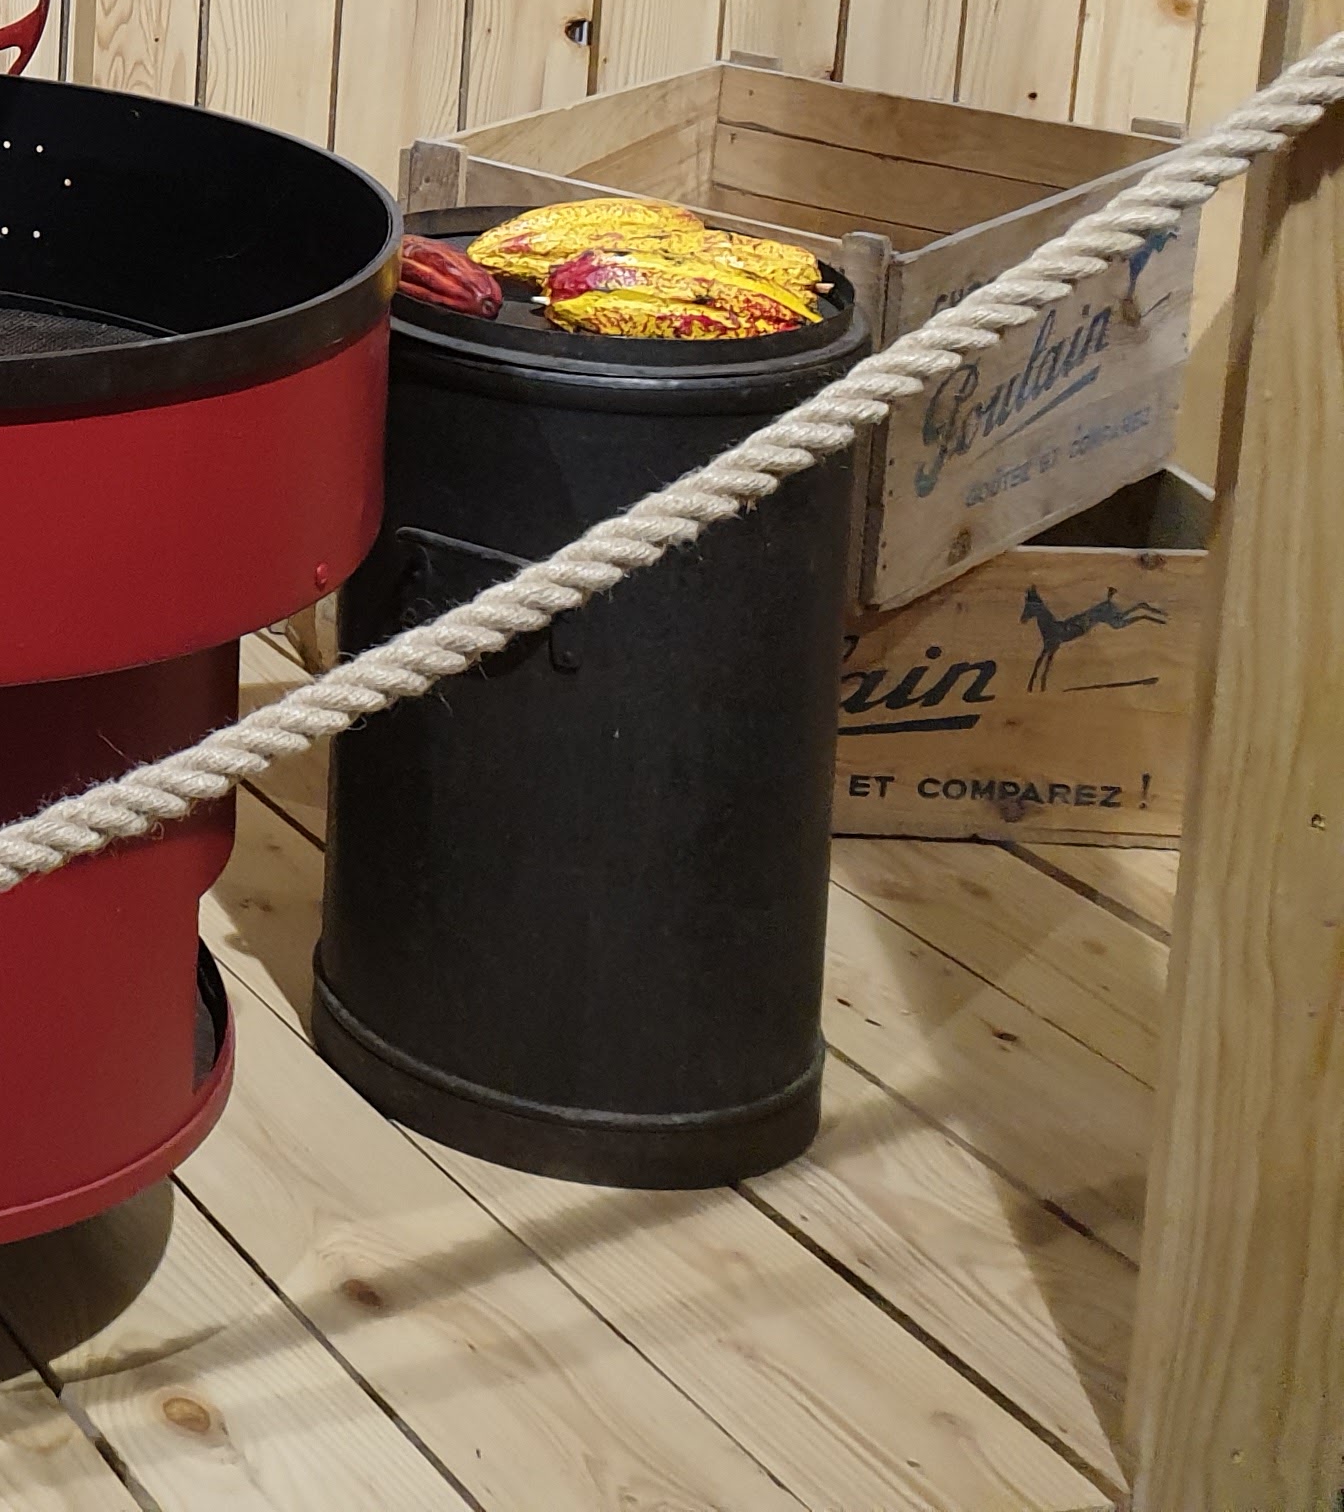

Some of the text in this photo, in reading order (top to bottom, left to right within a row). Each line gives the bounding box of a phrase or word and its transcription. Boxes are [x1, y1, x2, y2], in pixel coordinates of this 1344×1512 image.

[914, 303, 1112, 498] Poulain
[841, 635, 996, 714] ain
[848, 774, 895, 798] ET
[917, 777, 1123, 808] COMPAREZ
